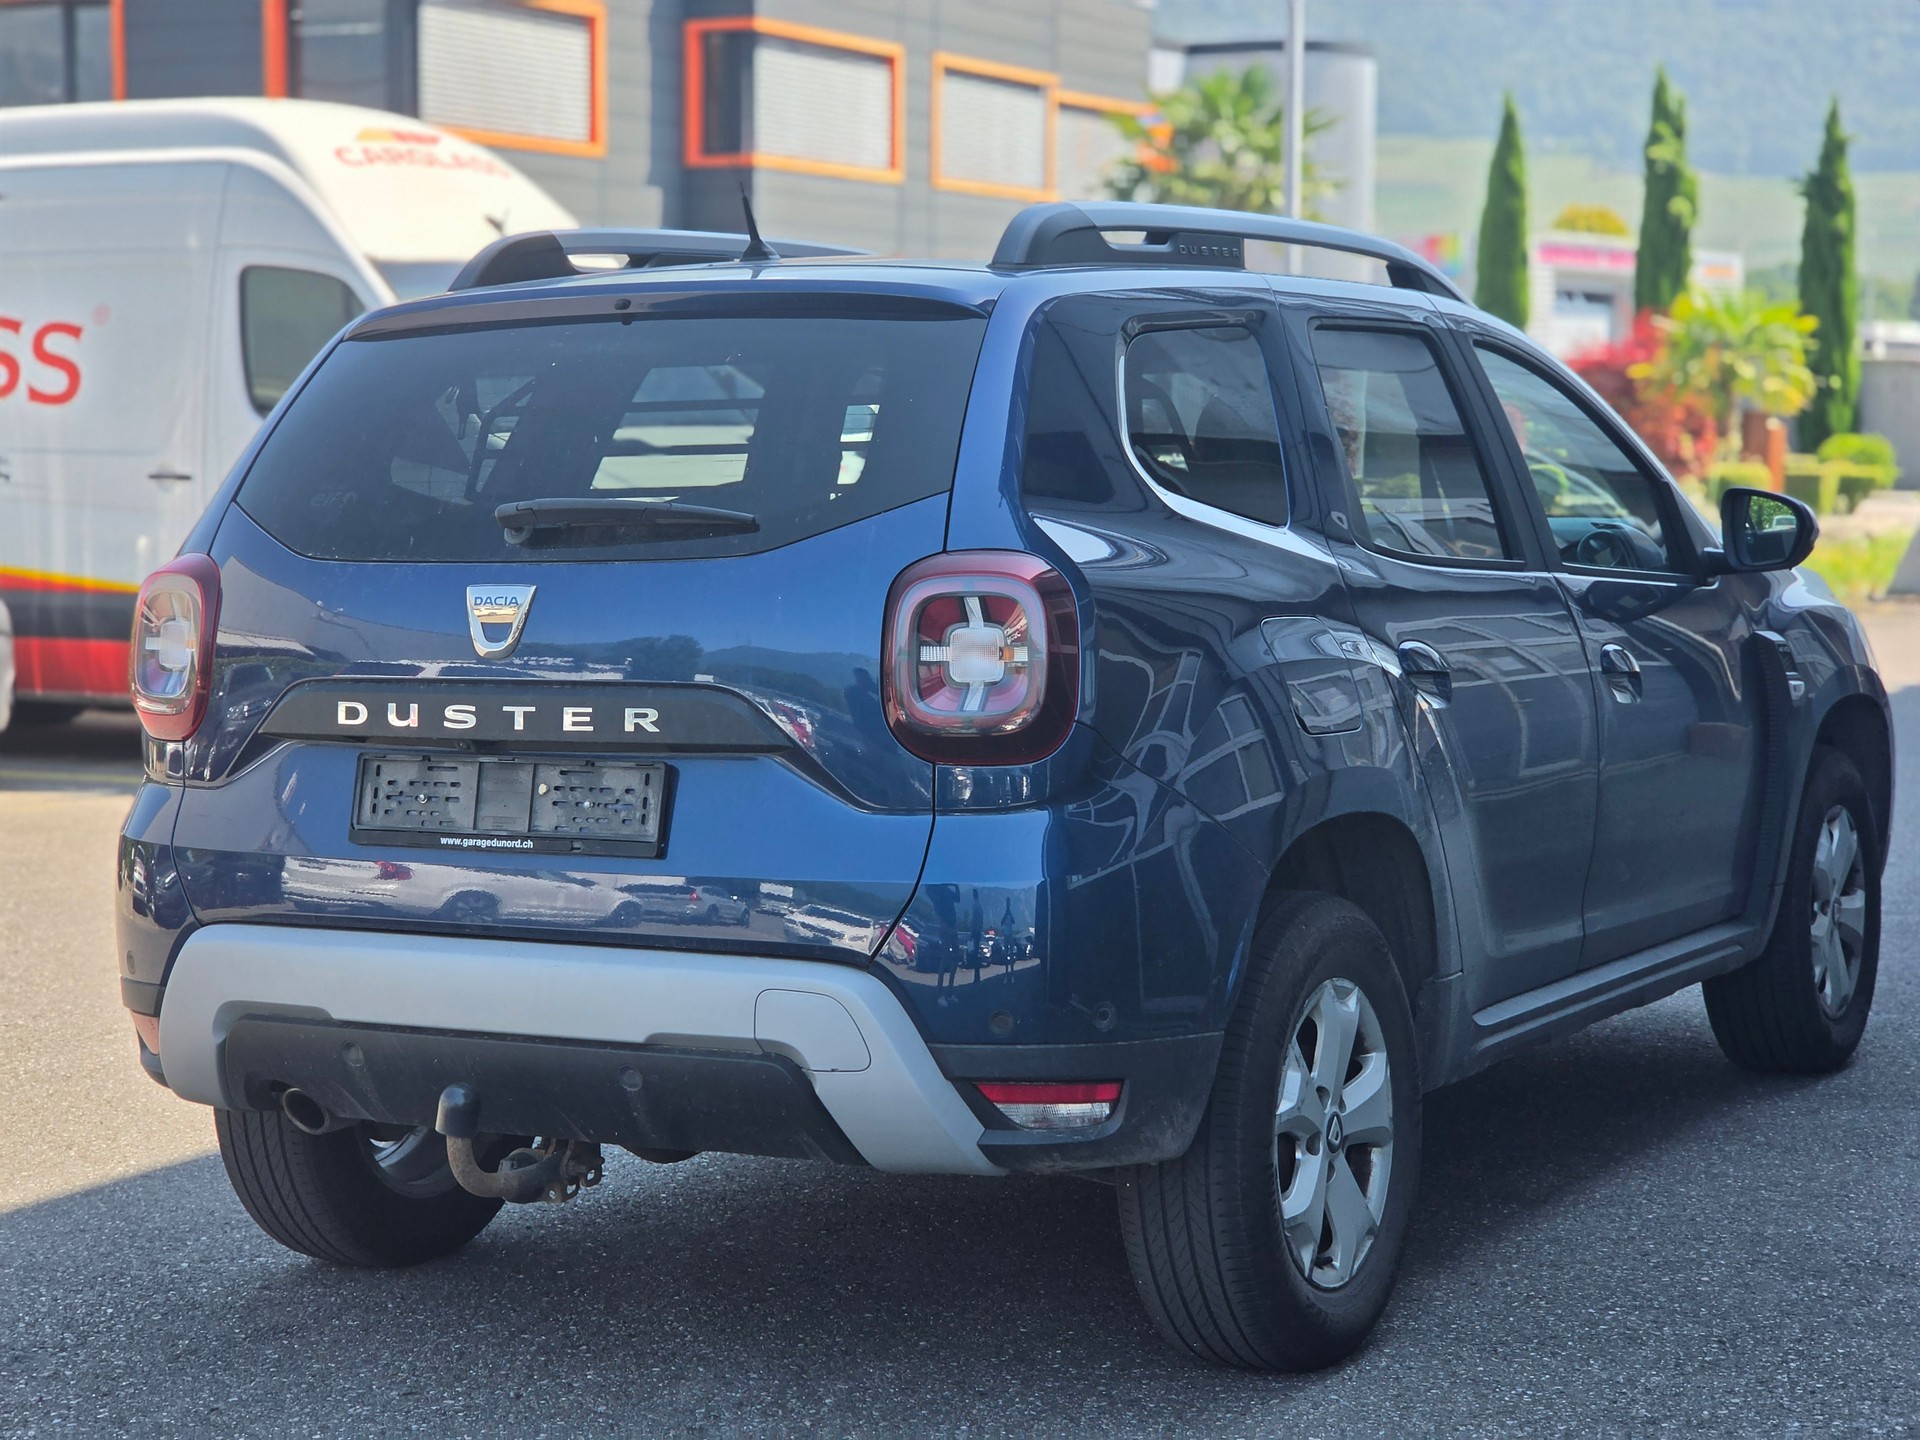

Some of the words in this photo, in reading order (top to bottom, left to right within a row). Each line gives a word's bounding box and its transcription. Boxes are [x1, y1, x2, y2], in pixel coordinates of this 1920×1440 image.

[1179, 245, 1240, 257] DUSTER
[474, 596, 519, 606] DACIA
[337, 701, 661, 733] DUSTER
[440, 837, 534, 848] www.garagedunord.ch
